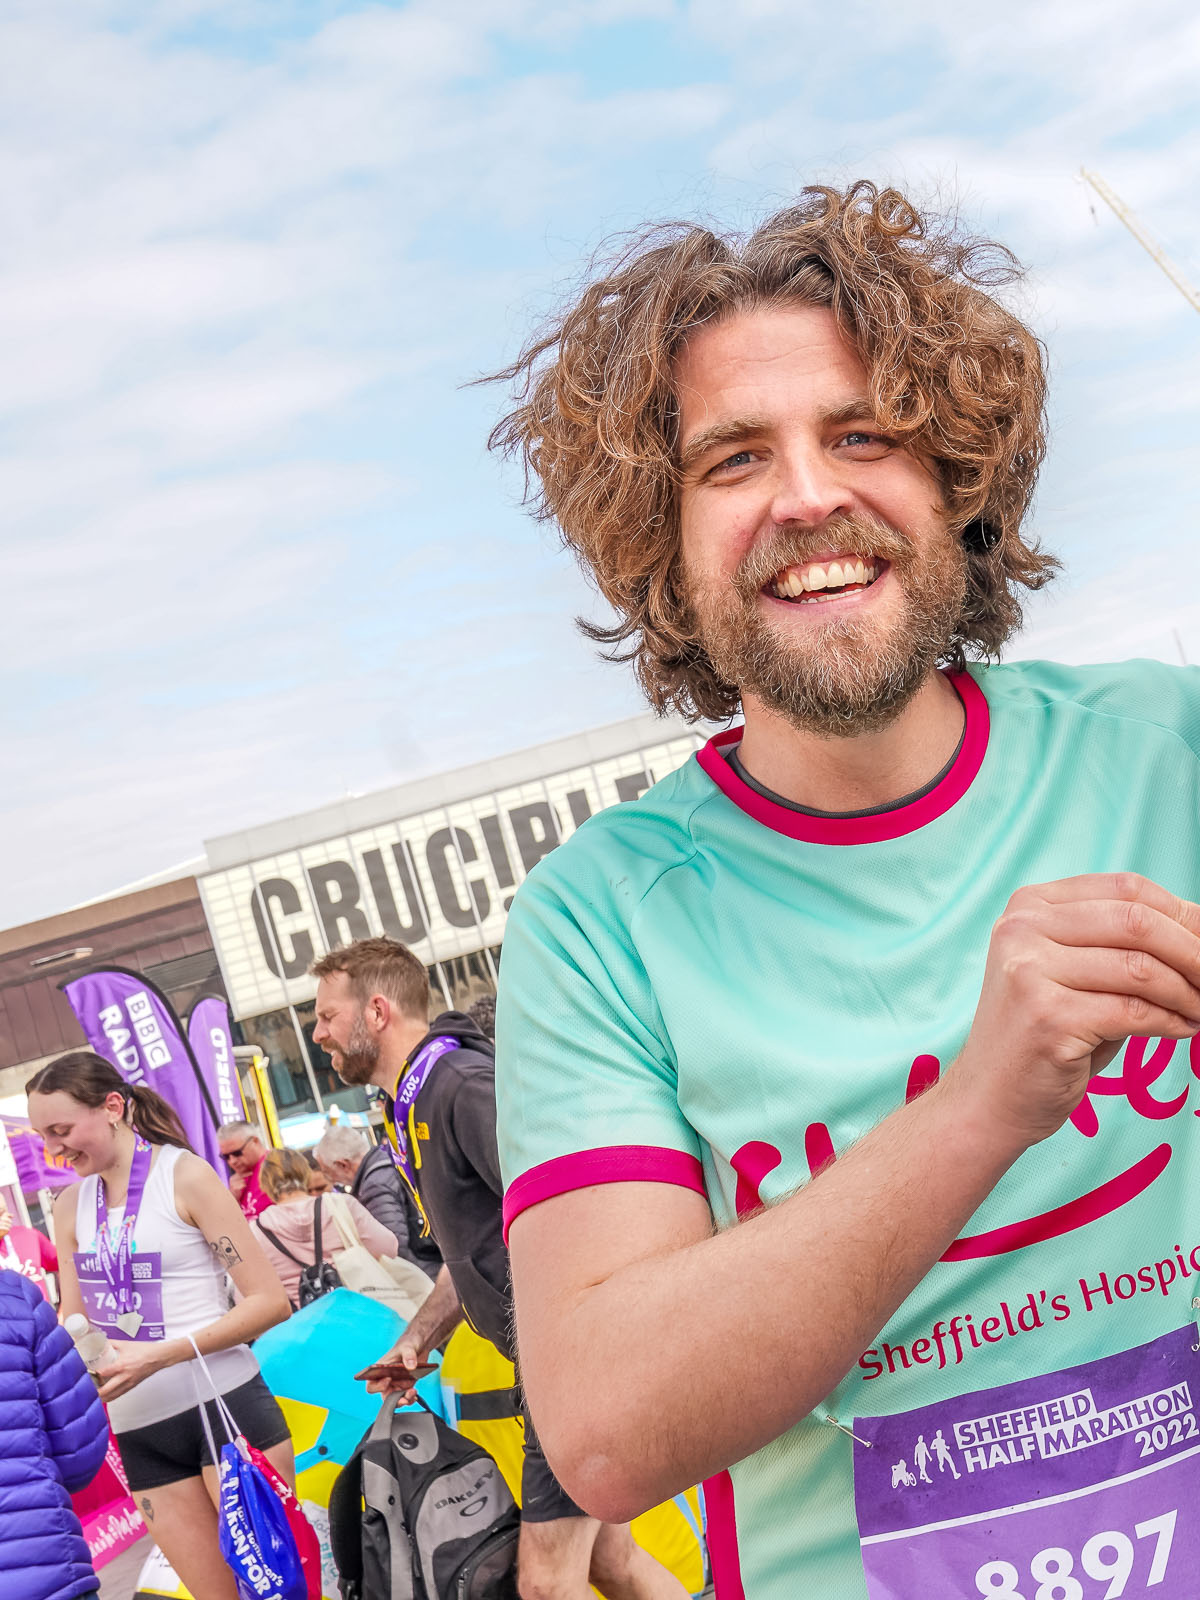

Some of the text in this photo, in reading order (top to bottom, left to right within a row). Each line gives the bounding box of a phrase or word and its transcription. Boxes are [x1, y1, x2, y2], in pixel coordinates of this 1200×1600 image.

[128, 996, 169, 1067] BBC
[399, 1074, 420, 1104] 2022
[859, 1290, 1071, 1381] Sheffield's
[958, 1393, 1092, 1447] SHEFFIELD
[964, 1385, 1190, 1473] HALF MARATHON
[1134, 1413, 1199, 1459] 2022
[434, 1469, 494, 1510] OAKLEY
[240, 1554, 272, 1596] FOR
[974, 1508, 1178, 1600] 8897
